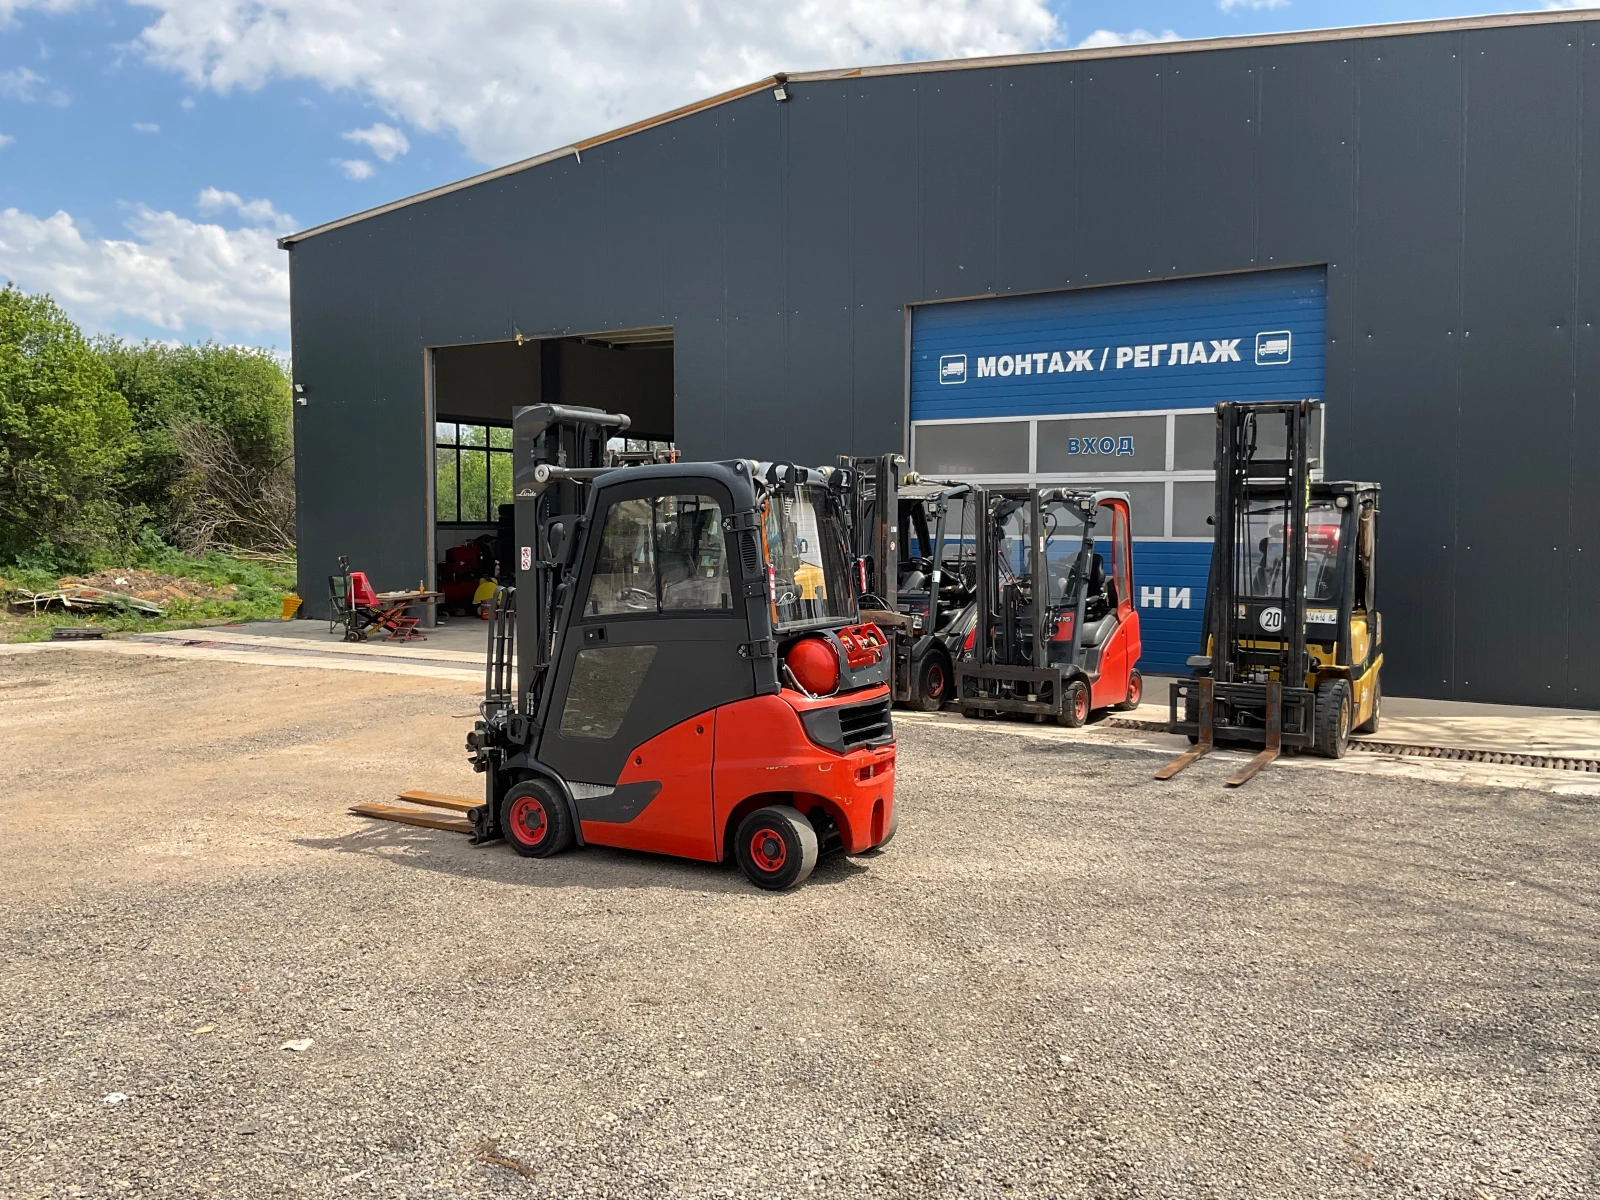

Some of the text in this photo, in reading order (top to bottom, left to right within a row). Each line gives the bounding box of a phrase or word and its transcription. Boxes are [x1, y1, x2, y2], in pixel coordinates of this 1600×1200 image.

[977, 338, 1242, 378] МОНТАЖ / РЕГЛАЖ
[1067, 436, 1135, 457] ВХОД
[515, 488, 537, 497] Linde
[1264, 611, 1281, 627] 20
